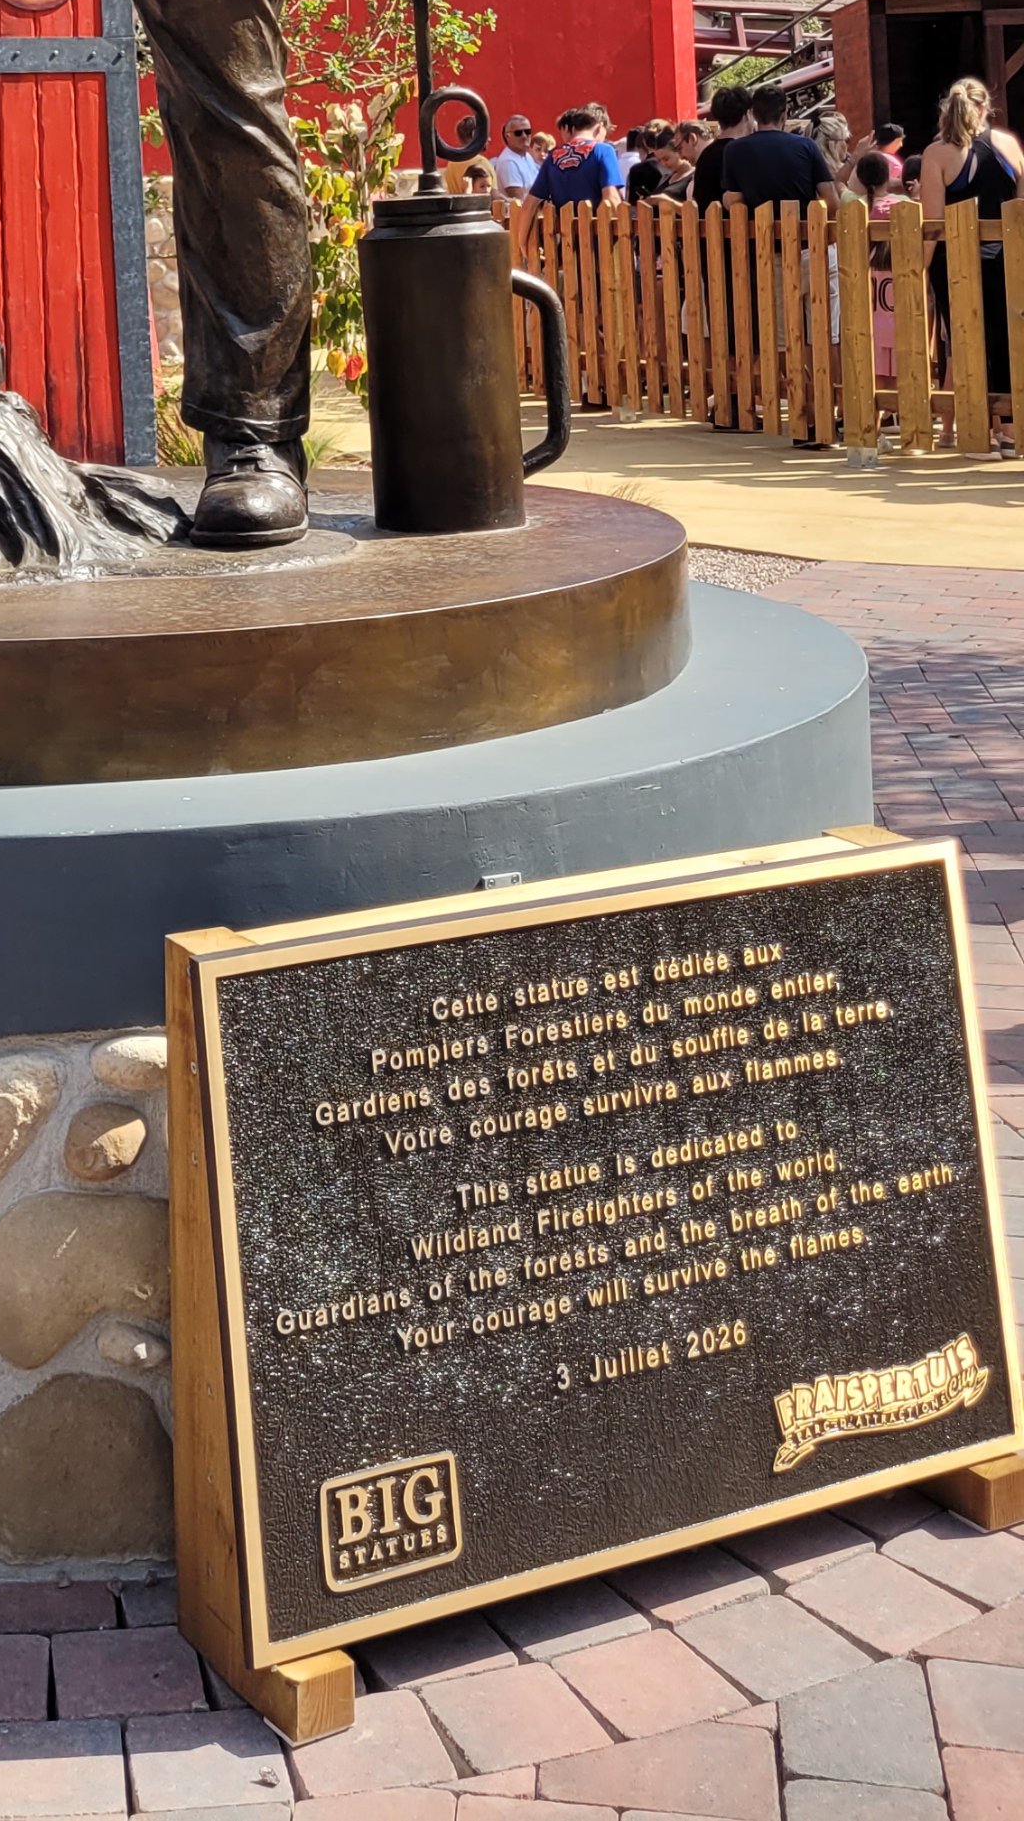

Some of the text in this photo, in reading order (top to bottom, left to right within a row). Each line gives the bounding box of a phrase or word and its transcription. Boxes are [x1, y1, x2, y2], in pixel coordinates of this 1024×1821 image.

[371, 971, 841, 1073] Pompiers Forestiers du monde entier,
[432, 942, 783, 1021] Cette statue est dédiée aux
[315, 1086, 432, 1126] Gardiens
[447, 1076, 491, 1101] des
[506, 1058, 578, 1090] forêts
[592, 1050, 617, 1073] et
[629, 1042, 658, 1067] du
[671, 1025, 750, 1059] souffle
[762, 1016, 791, 1041] de
[802, 1011, 824, 1033] la
[384, 1125, 453, 1155] Votre
[469, 1102, 568, 1139] courage
[583, 1080, 678, 1116] survivra
[692, 1071, 732, 1094] aux
[411, 1147, 843, 1261] Wildland Firefighters of the world,
[456, 1119, 797, 1209] This statue is dedicated to
[276, 1287, 411, 1335] Guardians
[428, 1271, 454, 1301] of
[469, 1266, 509, 1292] the
[524, 1243, 610, 1281] forests
[625, 1226, 666, 1258] and
[681, 1219, 716, 1244] the
[731, 1195, 803, 1232] breath
[816, 1187, 838, 1212] of
[850, 1179, 885, 1204] the
[397, 1320, 456, 1352] Your
[472, 1294, 572, 1334] courage
[588, 1278, 628, 1308] will
[644, 1257, 727, 1296] survive
[740, 1245, 776, 1271] the
[556, 1319, 748, 1391] 3 Juillet 2026
[776, 1336, 976, 1432] FRAISPERTUIS
[335, 1467, 446, 1545] BIG
[339, 1523, 447, 1569] STATUES
